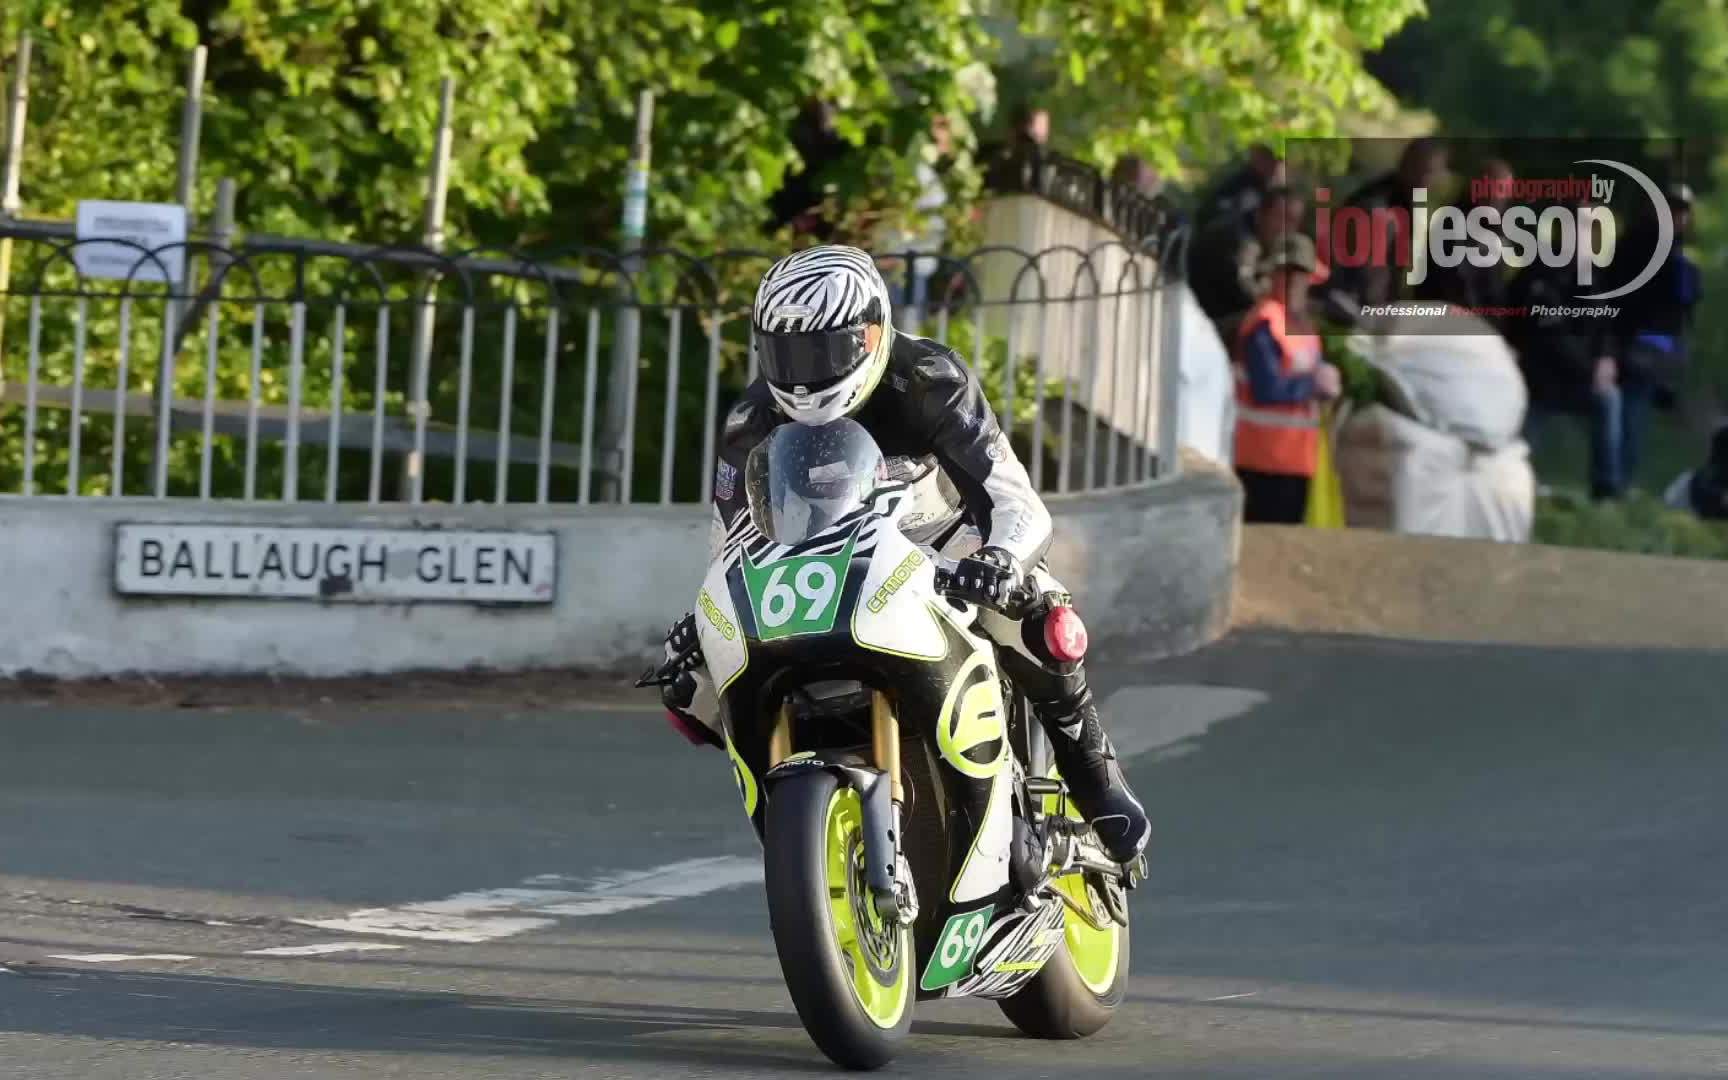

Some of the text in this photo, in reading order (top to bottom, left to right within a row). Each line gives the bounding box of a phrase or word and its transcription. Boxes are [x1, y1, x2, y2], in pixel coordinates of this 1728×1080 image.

[140, 539, 534, 584] BALLAUGH GLEN
[867, 551, 925, 613] CFMOTO
[761, 561, 836, 627] 69
[940, 914, 984, 968] 69
